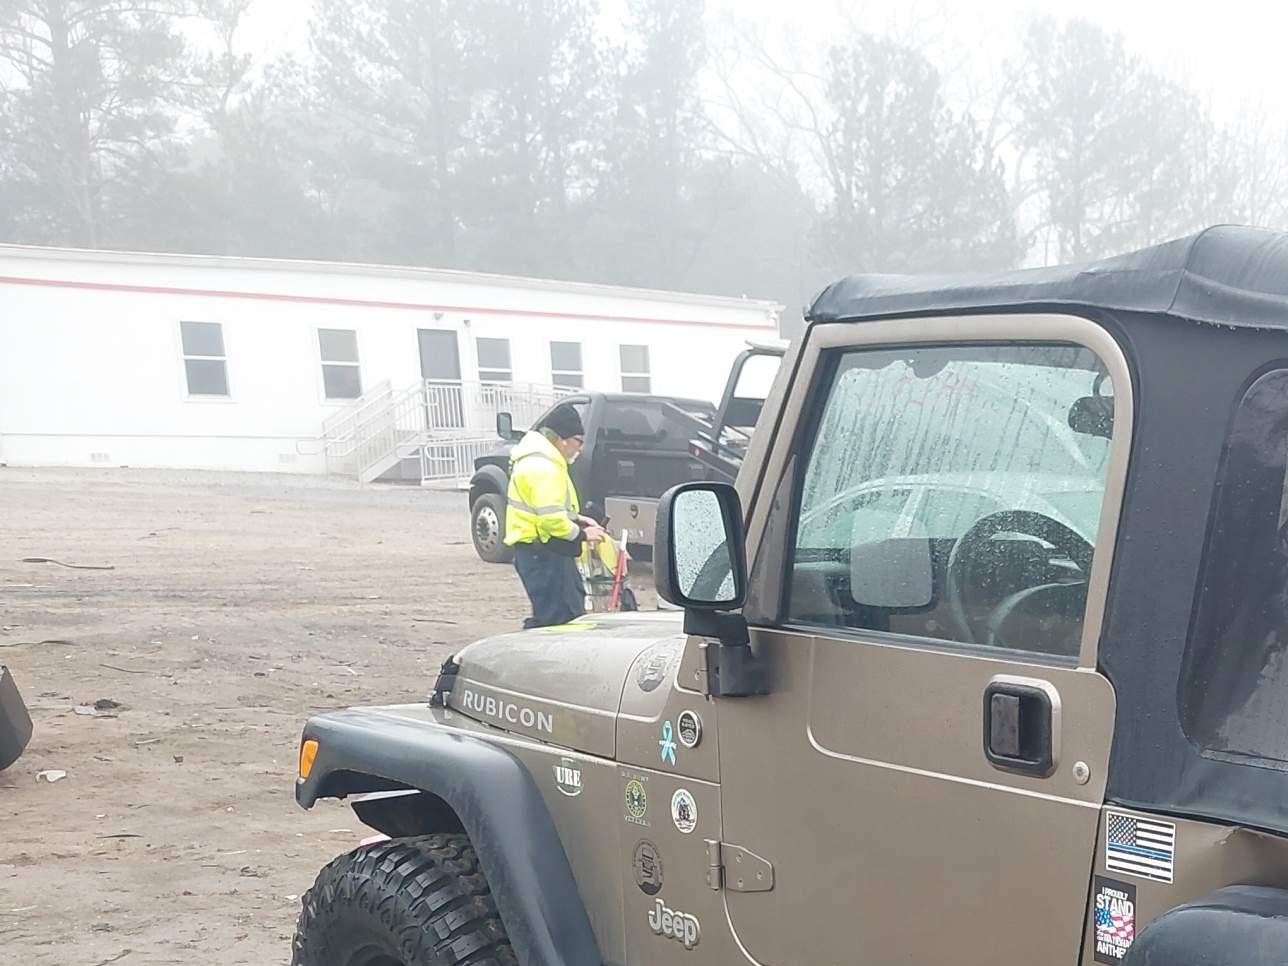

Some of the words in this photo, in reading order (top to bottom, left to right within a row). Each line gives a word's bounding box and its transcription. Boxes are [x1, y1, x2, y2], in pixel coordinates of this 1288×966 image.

[463, 689, 553, 733] RUBICON
[1096, 893, 1134, 918] STAND
[1104, 887, 1129, 900] PROUDLY
[648, 898, 700, 949] Jeep
[1096, 940, 1127, 959] ANTHE
